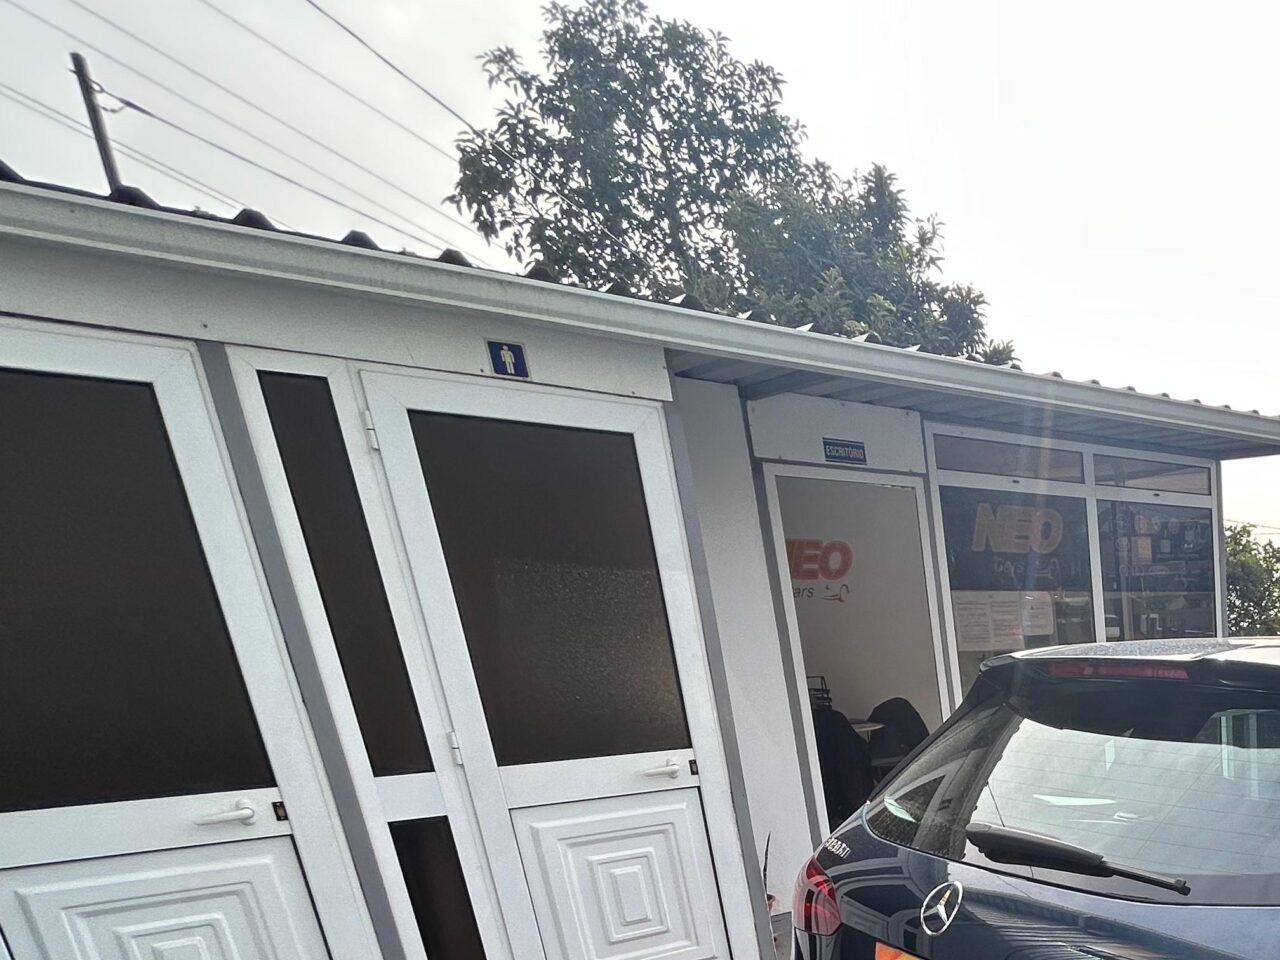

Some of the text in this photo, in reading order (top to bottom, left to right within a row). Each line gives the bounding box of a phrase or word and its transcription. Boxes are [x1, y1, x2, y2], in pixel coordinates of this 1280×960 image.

[825, 445, 864, 459] ESCRITÓRIO
[971, 502, 1064, 554] NEO
[793, 586, 815, 599] ars
